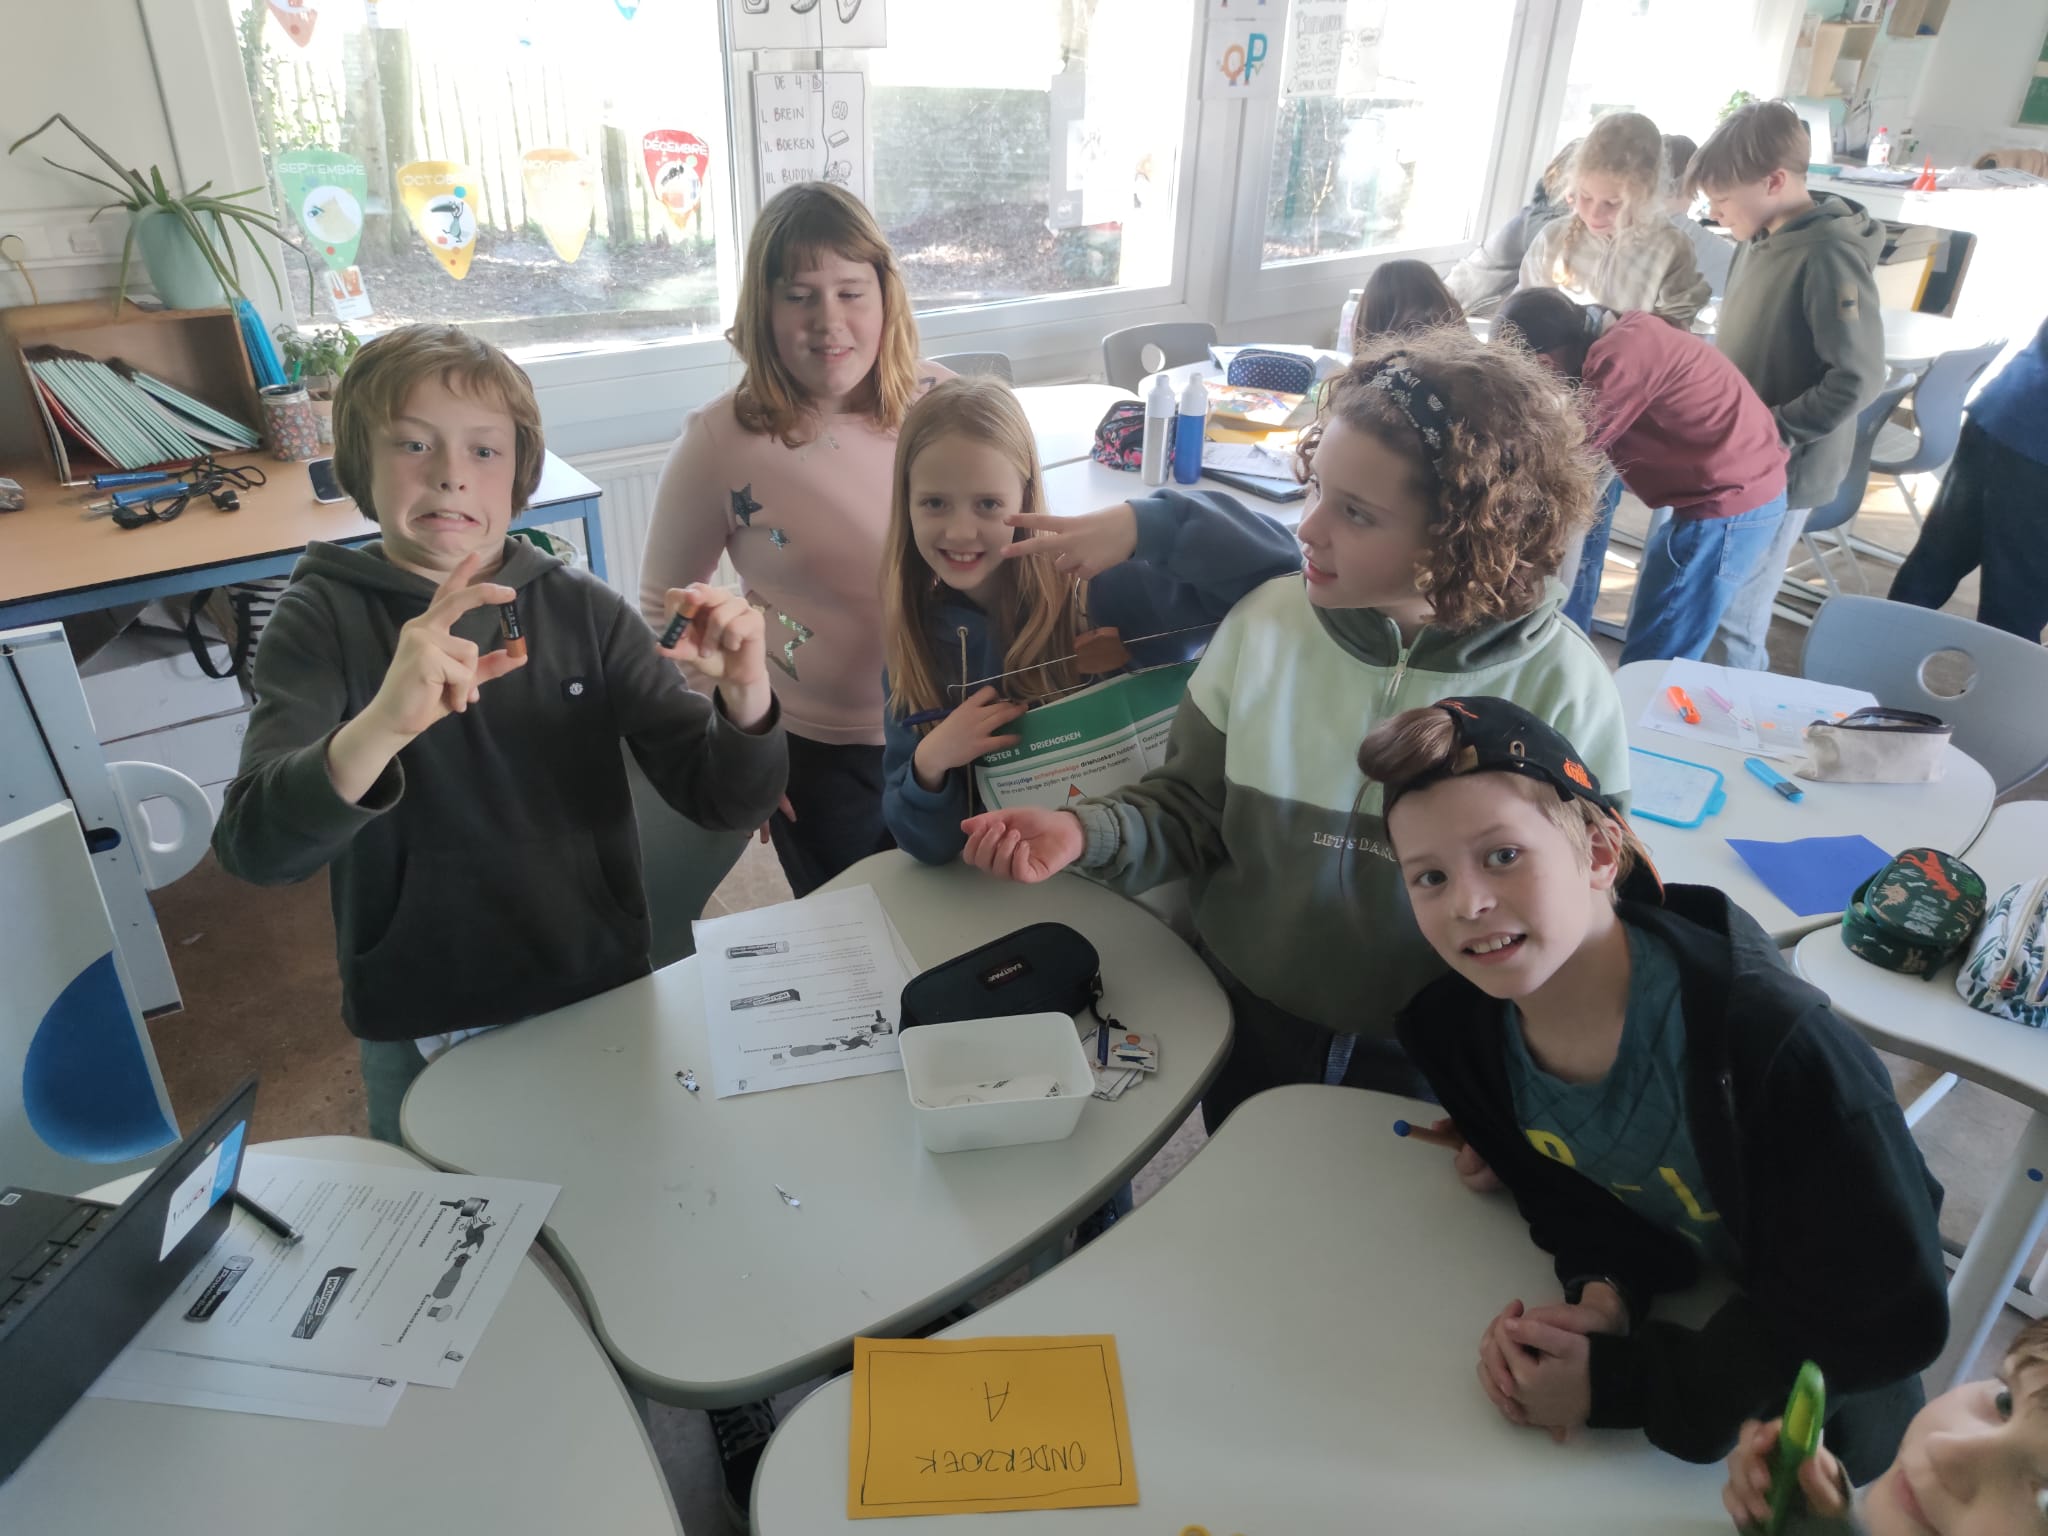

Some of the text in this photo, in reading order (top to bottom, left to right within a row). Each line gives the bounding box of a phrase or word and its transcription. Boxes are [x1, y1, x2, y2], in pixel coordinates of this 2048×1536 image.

[774, 75, 786, 90] DE
[795, 74, 802, 89] 4
[774, 106, 805, 122] BREIN
[776, 137, 815, 152] BOEKEN
[279, 160, 367, 176] SEPTEMBRE
[781, 168, 814, 184] BUDDY
[1029, 730, 1083, 752] DRIEHOEKEN
[1080, 752, 1117, 768] driehoeken
[1116, 743, 1137, 756] hebben
[1083, 763, 1107, 777] scherpe
[988, 963, 1022, 982] EASTPAK
[317, 1278, 338, 1314] HOLLYWOOD
[984, 1381, 1010, 1423] A
[915, 1441, 1086, 1474] ONDERZOEK
